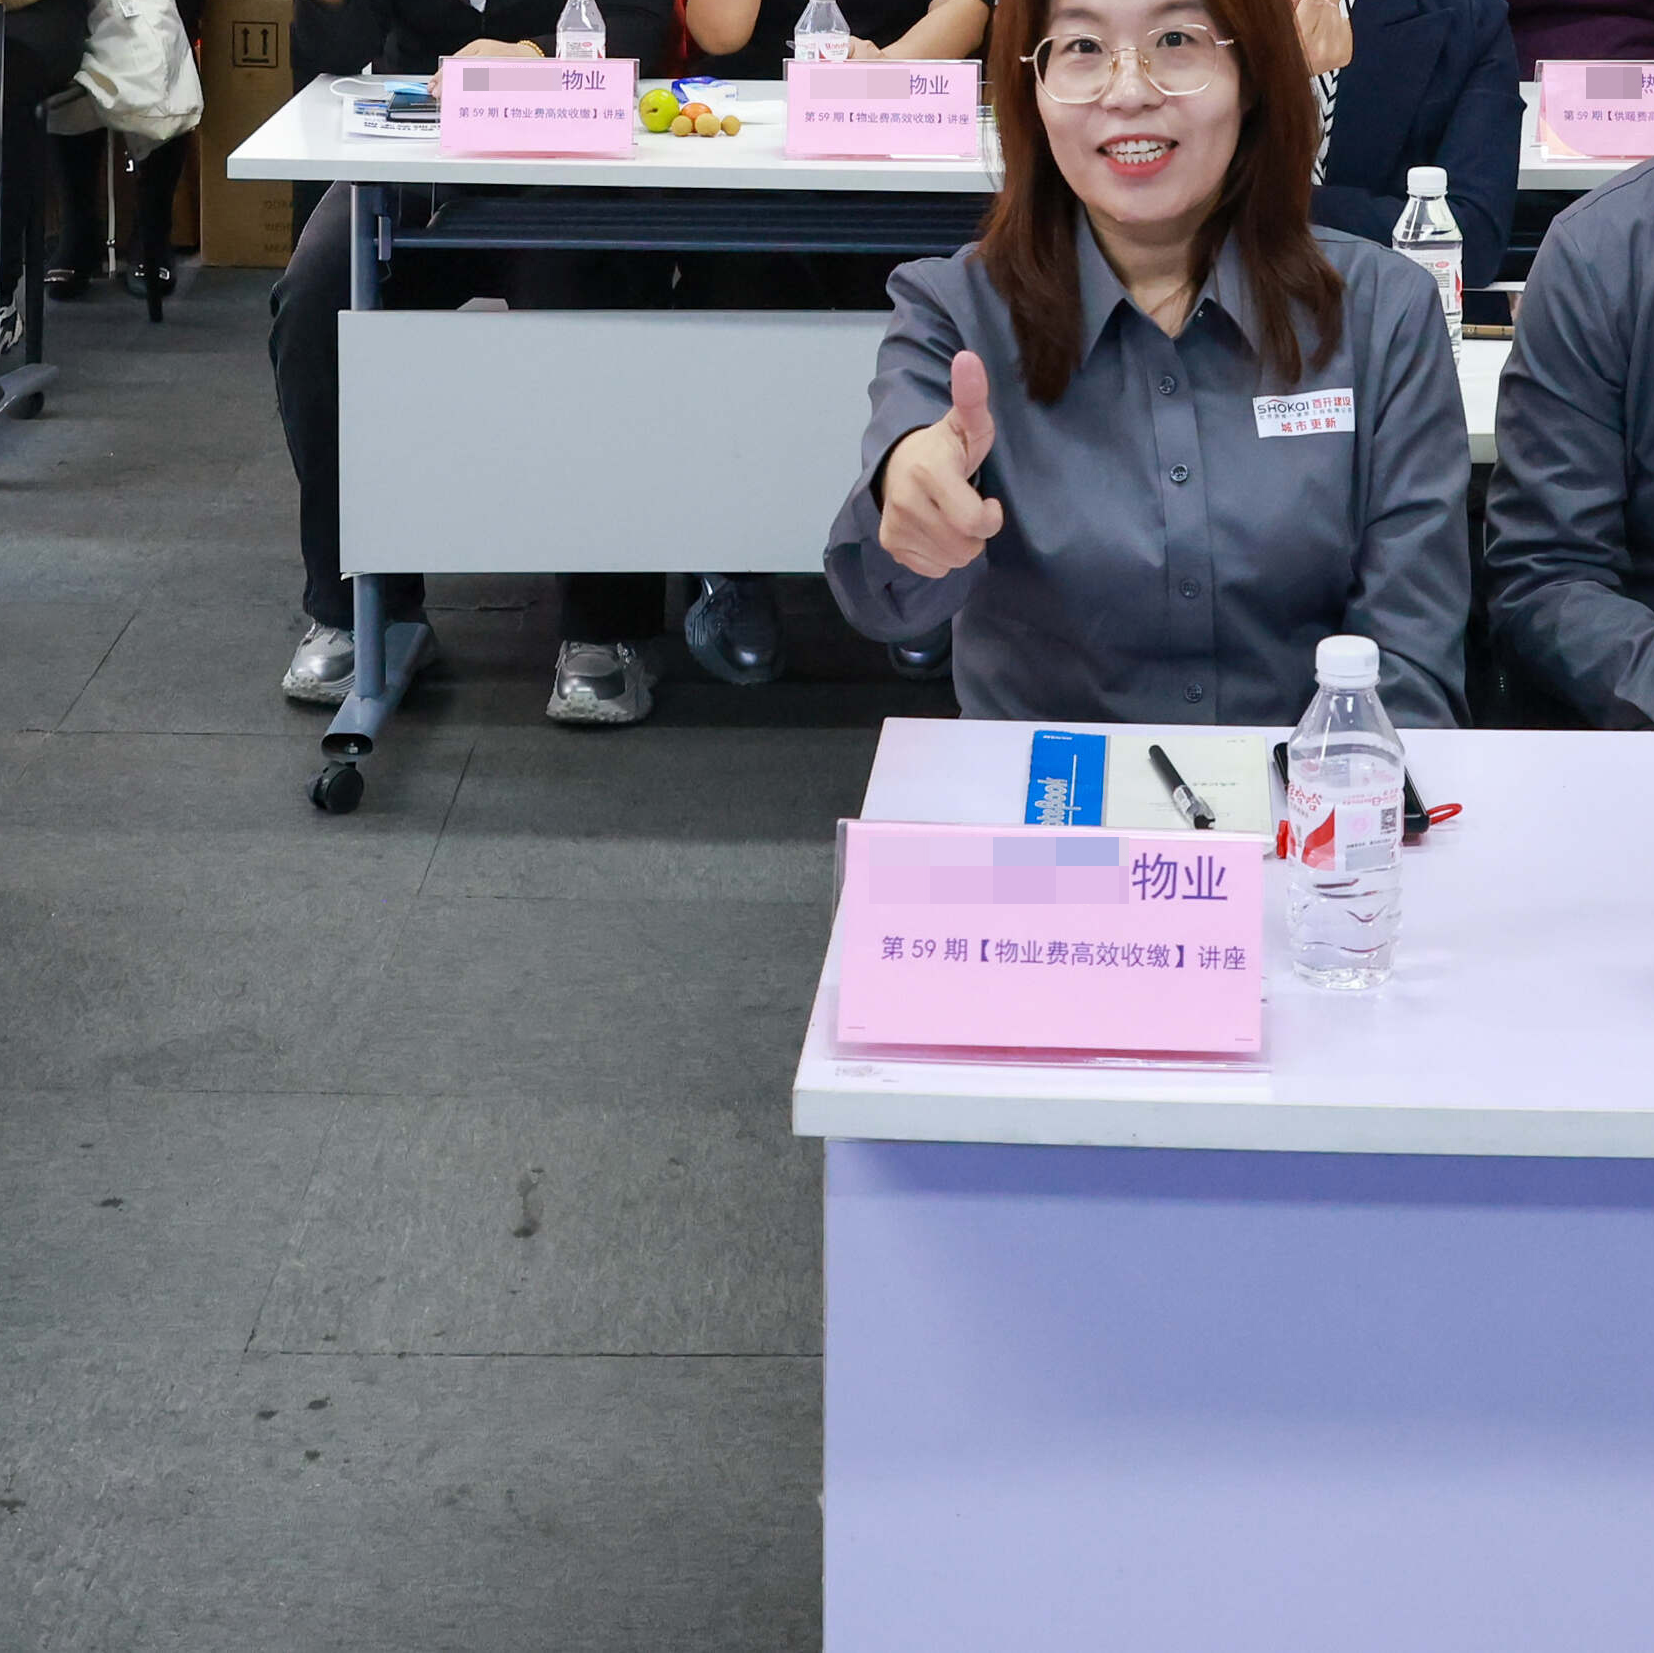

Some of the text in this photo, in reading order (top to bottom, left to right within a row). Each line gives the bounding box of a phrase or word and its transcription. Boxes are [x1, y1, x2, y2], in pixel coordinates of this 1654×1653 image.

[561, 69, 606, 91] 物业
[909, 74, 950, 96] 物业
[1281, 417, 1337, 433] 城市更新
[1131, 852, 1229, 903] 物业
